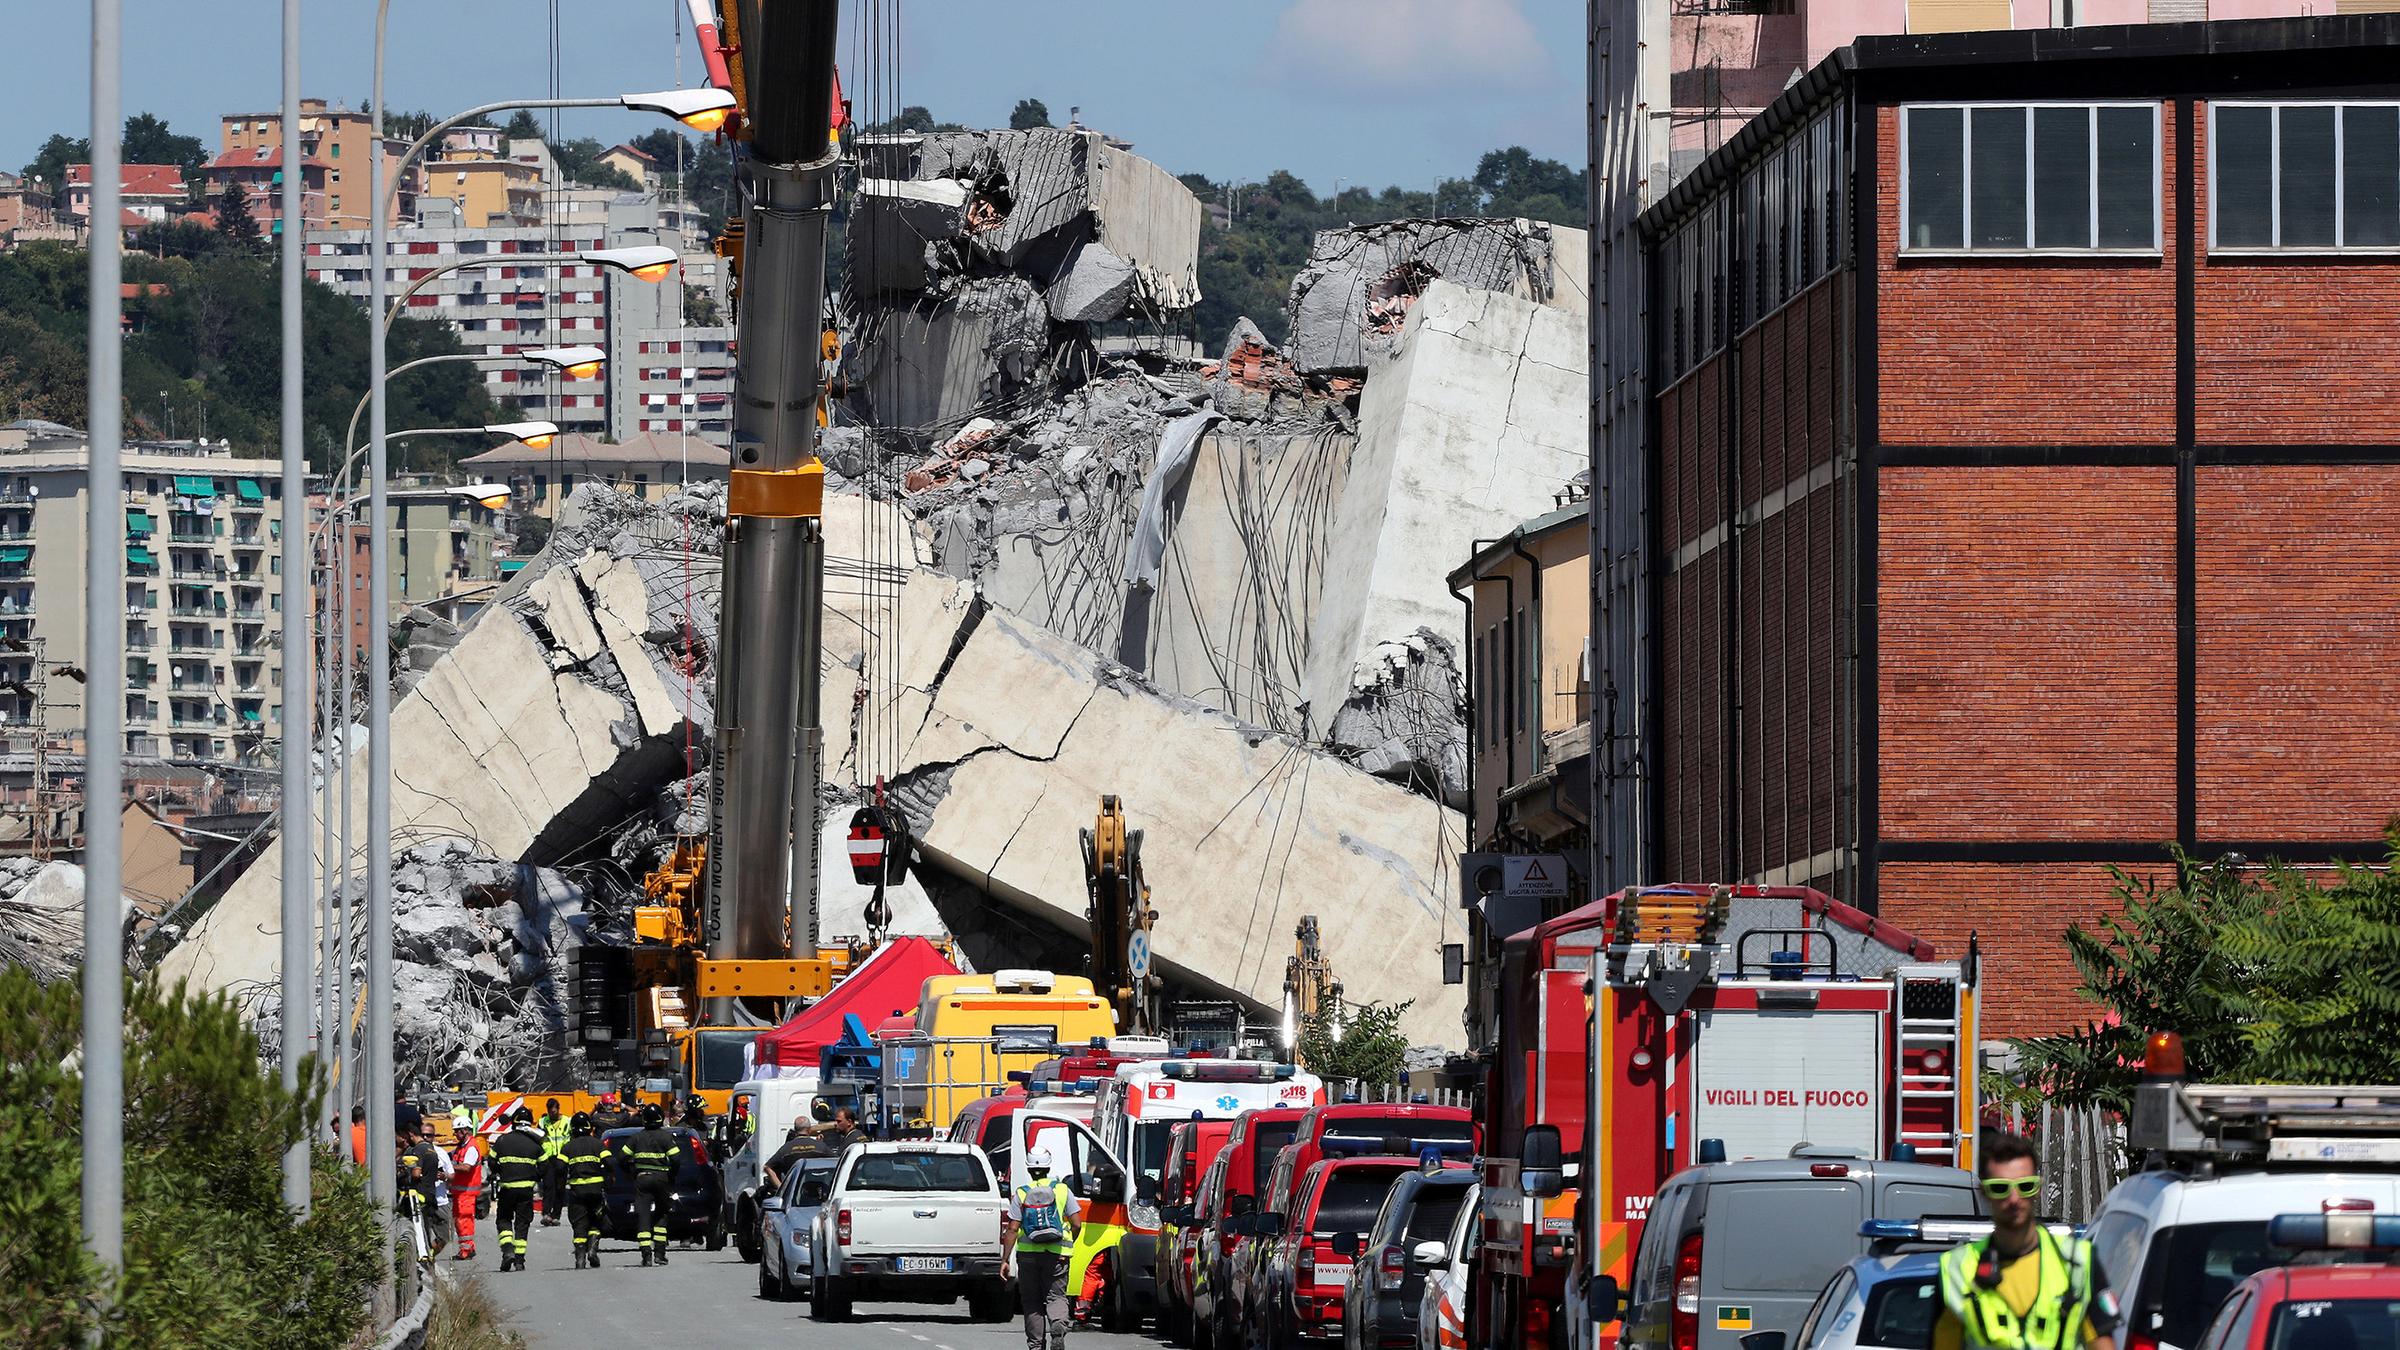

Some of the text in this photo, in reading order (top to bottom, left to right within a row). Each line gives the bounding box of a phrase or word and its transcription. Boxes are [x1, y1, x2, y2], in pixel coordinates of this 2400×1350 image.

[812, 751, 821, 797] LOAD
[715, 779, 725, 806] 900
[712, 813, 723, 889] MOMENT
[810, 805, 820, 878] MOMENT
[711, 895, 721, 941] LOAD
[809, 887, 818, 914] 900
[1289, 1085, 1307, 1096] 118
[1705, 1090, 1869, 1106] VIGILI DEL FUOCO
